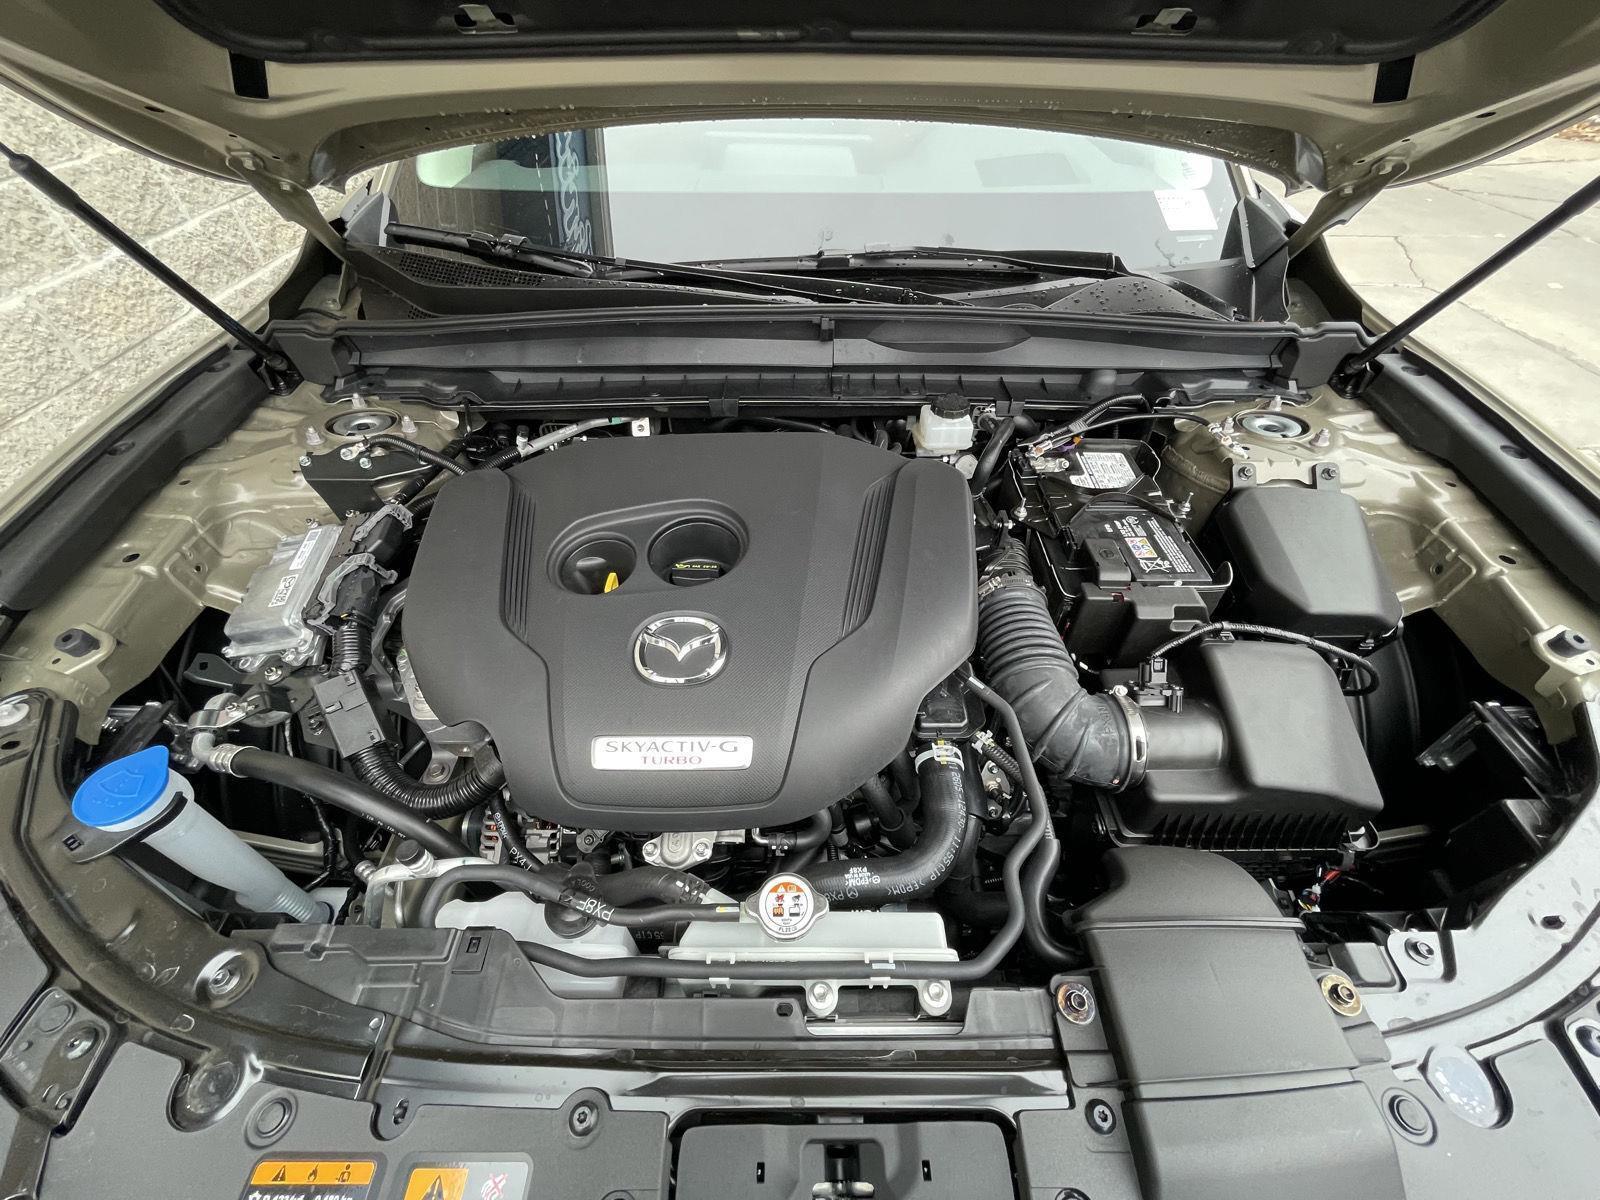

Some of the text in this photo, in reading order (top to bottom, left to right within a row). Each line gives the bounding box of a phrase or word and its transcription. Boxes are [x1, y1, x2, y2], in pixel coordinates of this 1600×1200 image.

[605, 740, 738, 753] SKYACTIV-G
[640, 755, 703, 765] TURBO
[576, 896, 615, 922] PX8F
